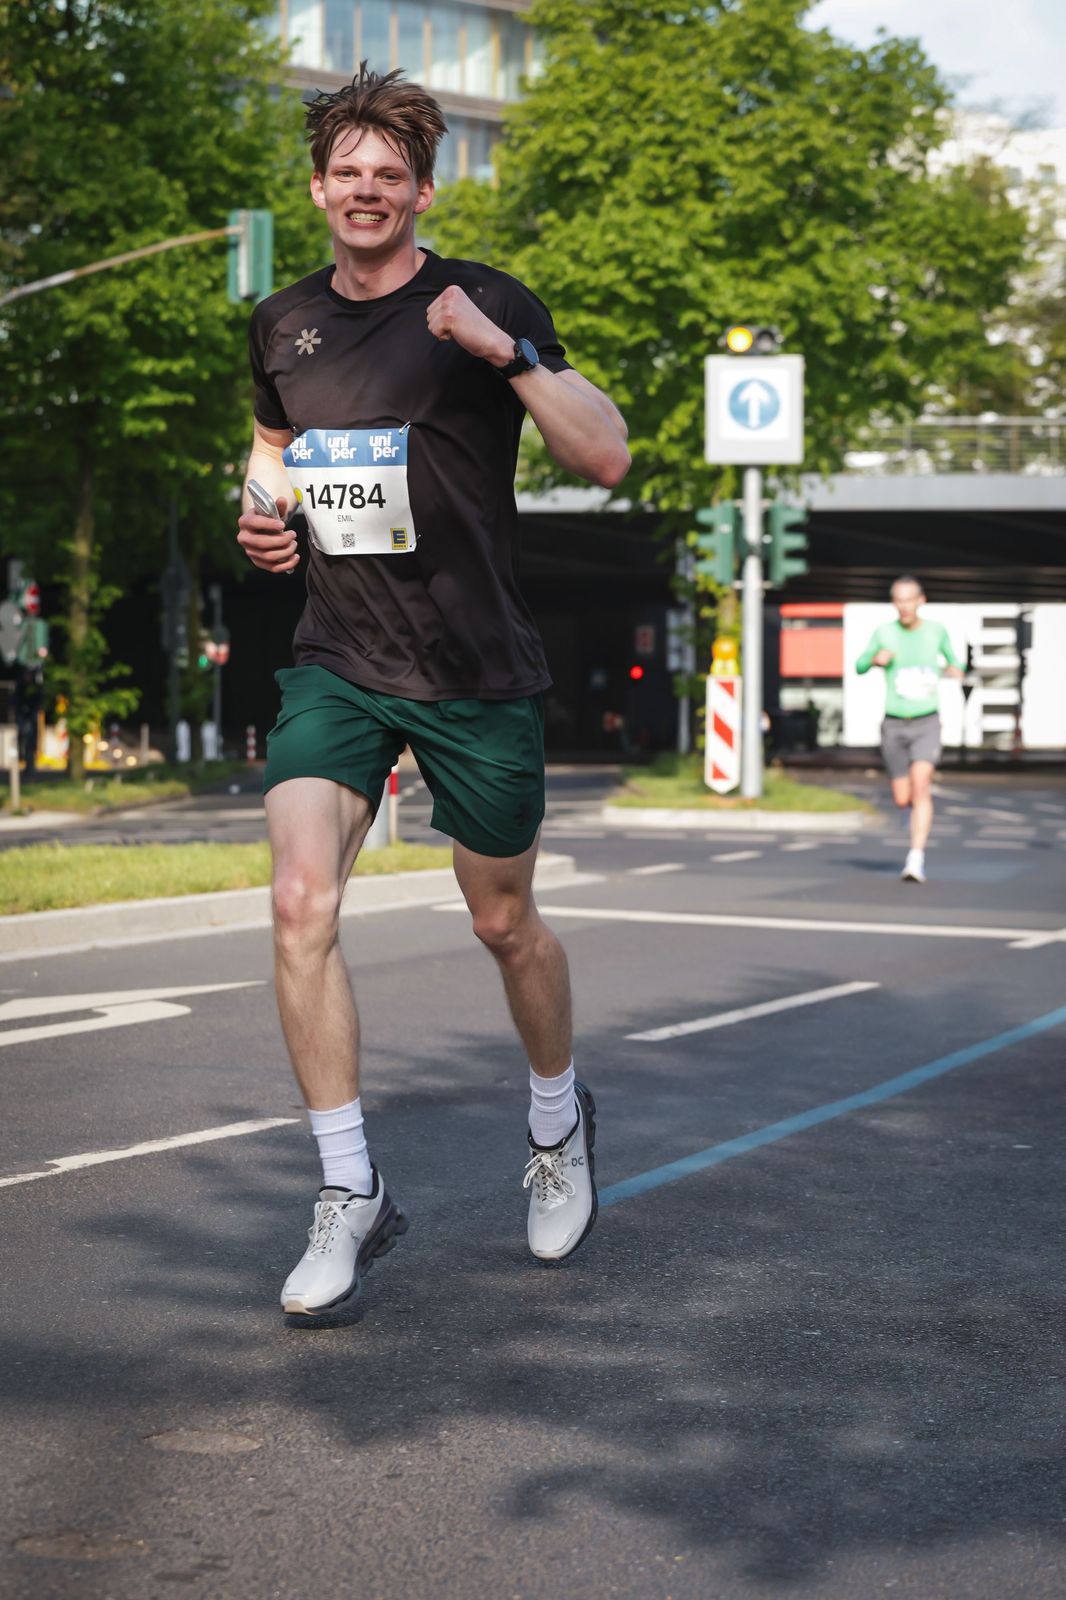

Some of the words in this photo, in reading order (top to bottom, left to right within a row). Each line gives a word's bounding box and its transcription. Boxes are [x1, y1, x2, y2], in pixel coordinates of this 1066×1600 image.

[328, 433, 350, 448] uni
[369, 432, 392, 447] uni
[291, 448, 314, 463] per
[331, 447, 357, 463] per
[373, 446, 399, 462] per
[306, 483, 387, 509] 14784
[337, 514, 354, 522] EMIL
